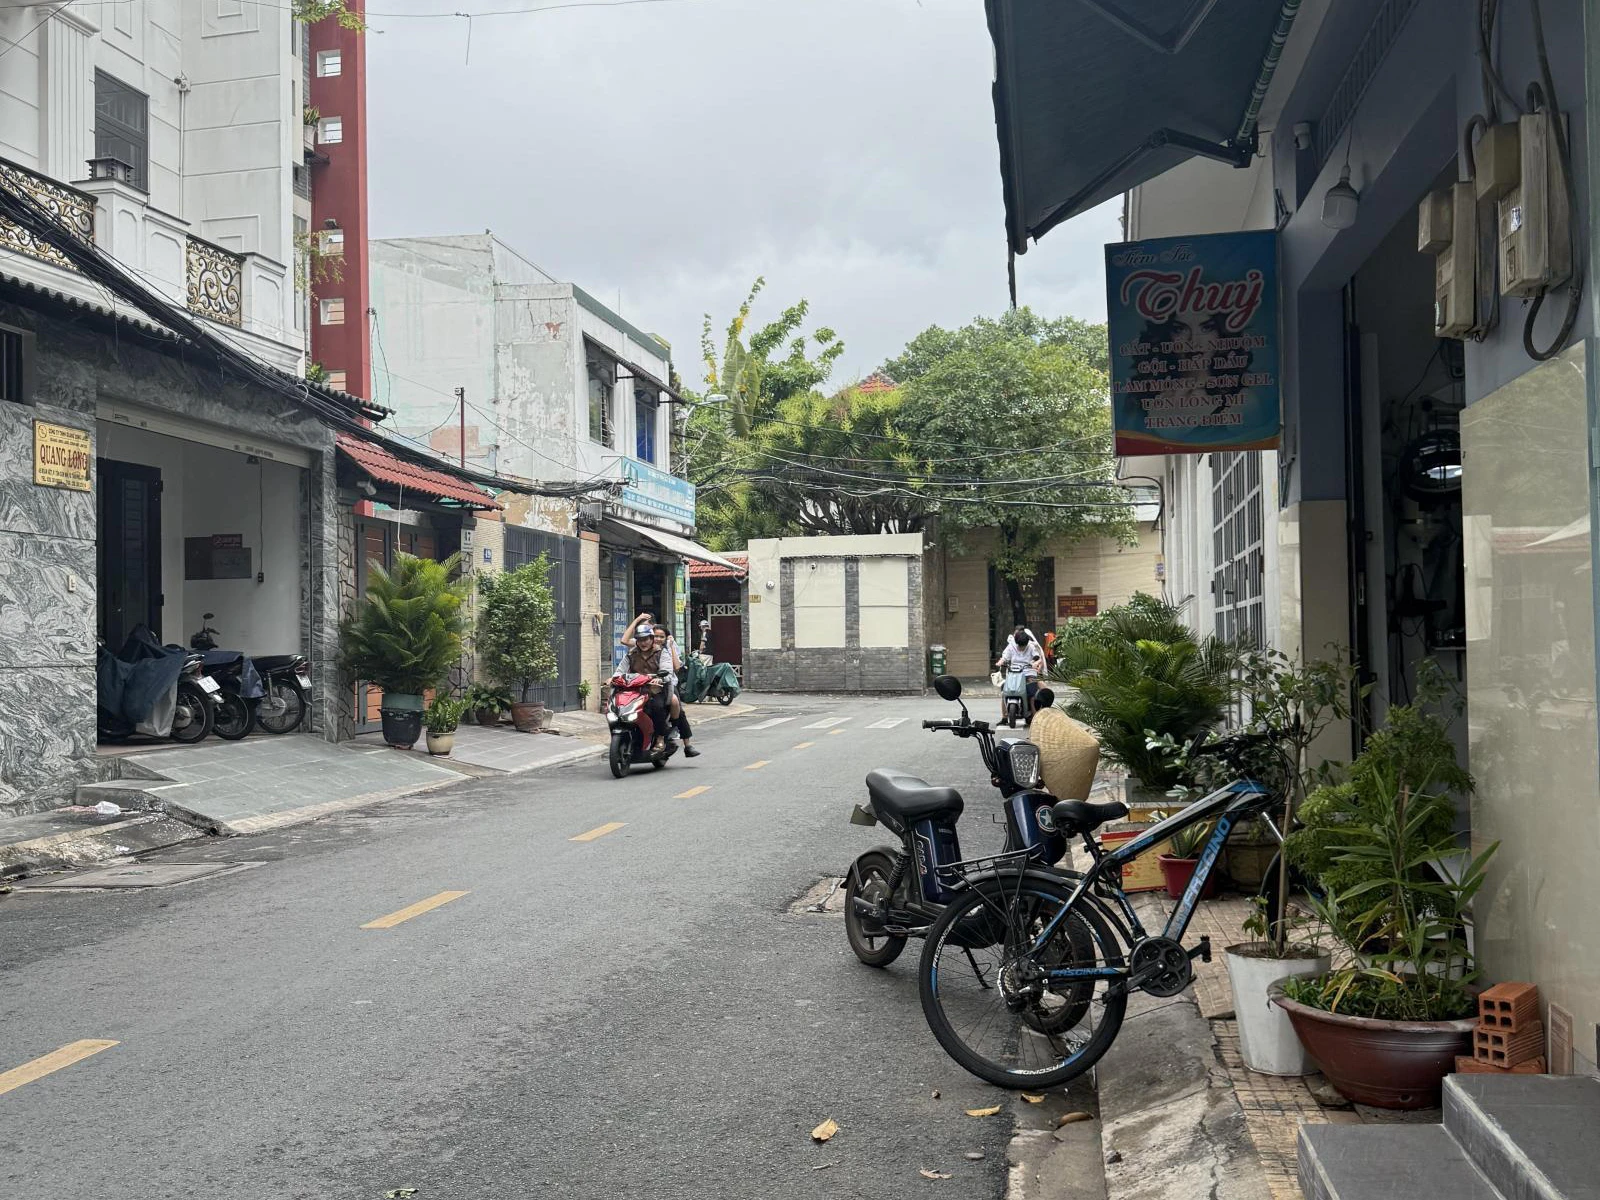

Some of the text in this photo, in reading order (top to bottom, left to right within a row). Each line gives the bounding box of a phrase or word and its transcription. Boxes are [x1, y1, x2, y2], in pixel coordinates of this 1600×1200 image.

[1137, 357, 1167, 376] GỘI
[1242, 372, 1274, 387] GEL
[1145, 415, 1197, 428] TRANG
[40, 444, 66, 467] QUANG
[1180, 815, 1233, 906] FASCINO
